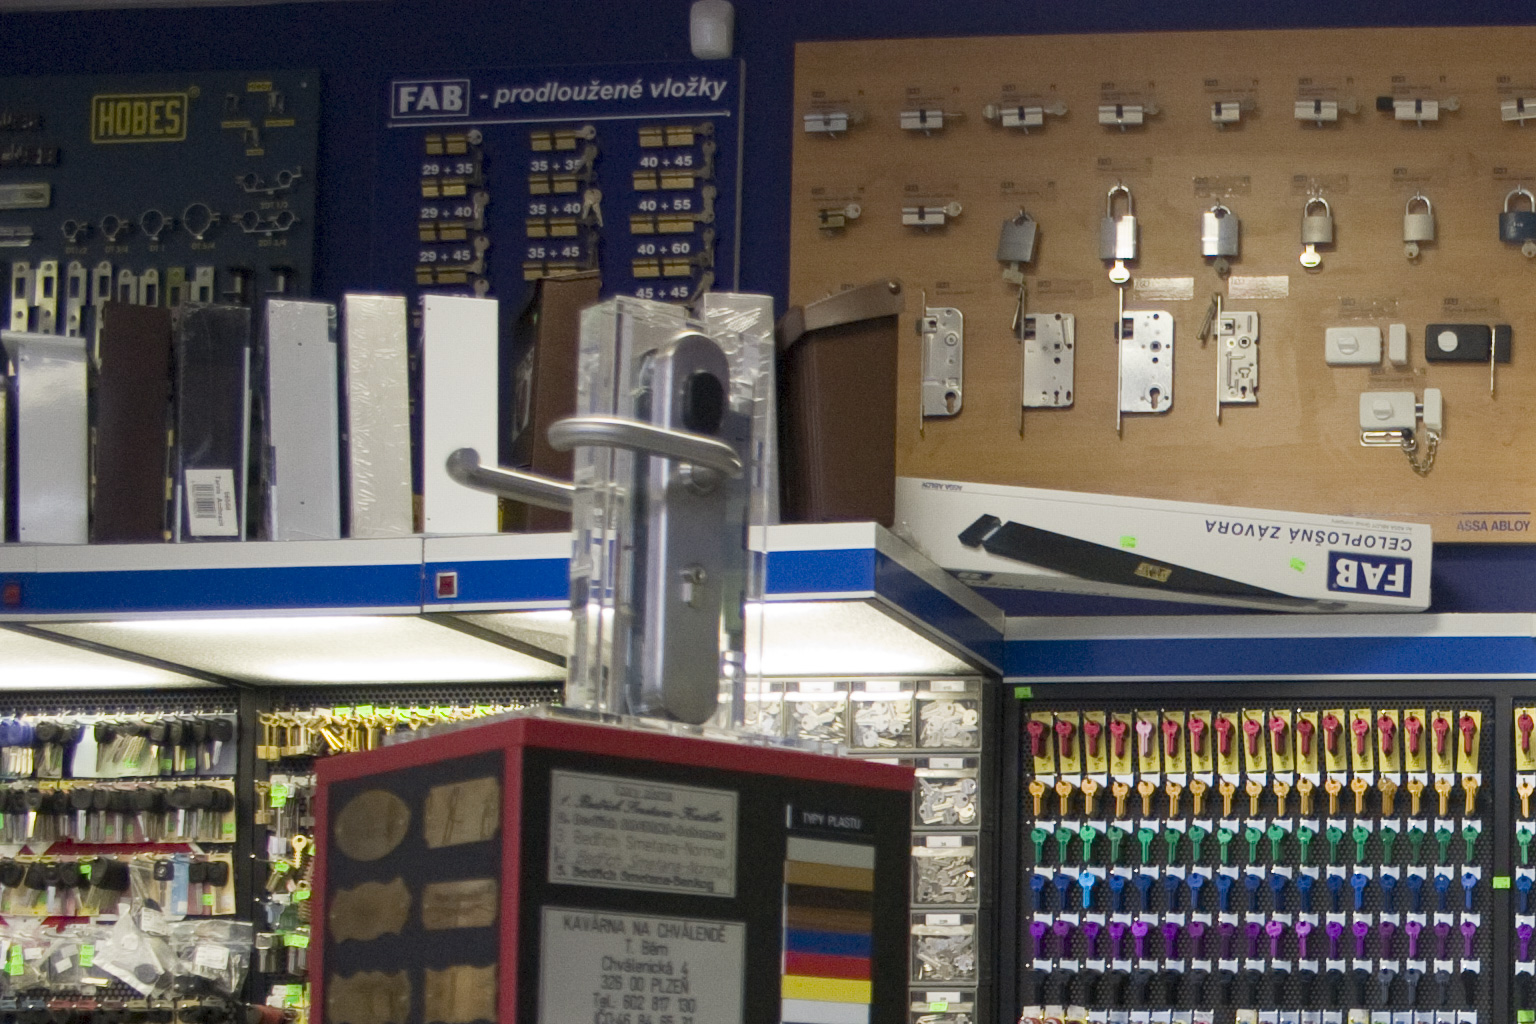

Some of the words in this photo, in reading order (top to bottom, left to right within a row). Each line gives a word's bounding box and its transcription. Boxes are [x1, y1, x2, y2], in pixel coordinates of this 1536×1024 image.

[399, 85, 464, 113] FAB
[495, 79, 643, 109] prodloužené
[651, 77, 728, 101] vložky
[98, 100, 181, 136] HOBES
[530, 161, 548, 172] 35
[640, 157, 658, 168] 40
[674, 155, 693, 167] 45
[422, 164, 440, 175] 29
[456, 163, 473, 175] 35
[529, 204, 547, 215] 35
[563, 203, 581, 214] 40
[639, 201, 657, 212] 40
[672, 199, 691, 210] 55
[421, 208, 438, 219] 29
[454, 207, 472, 218] 40
[528, 248, 545, 259] 35
[561, 246, 579, 258] 45
[637, 244, 655, 255] 40
[672, 242, 690, 253] 60
[419, 251, 437, 262] 29
[452, 250, 471, 262] 45
[636, 287, 653, 299] 45
[669, 286, 689, 297] 45
[1205, 519, 1280, 540] ZÁVORA
[1456, 521, 1488, 532] ASSA
[1491, 520, 1530, 532] ABLOY
[1289, 527, 1412, 552] CELOPLOŠNÁ
[1336, 557, 1406, 593] FAB
[803, 812, 824, 825] TYPY
[827, 815, 861, 830] PLASTU
[564, 912, 625, 934] KAVÁRNA
[632, 921, 650, 936] NA
[652, 975, 689, 994] PLZEŇ
